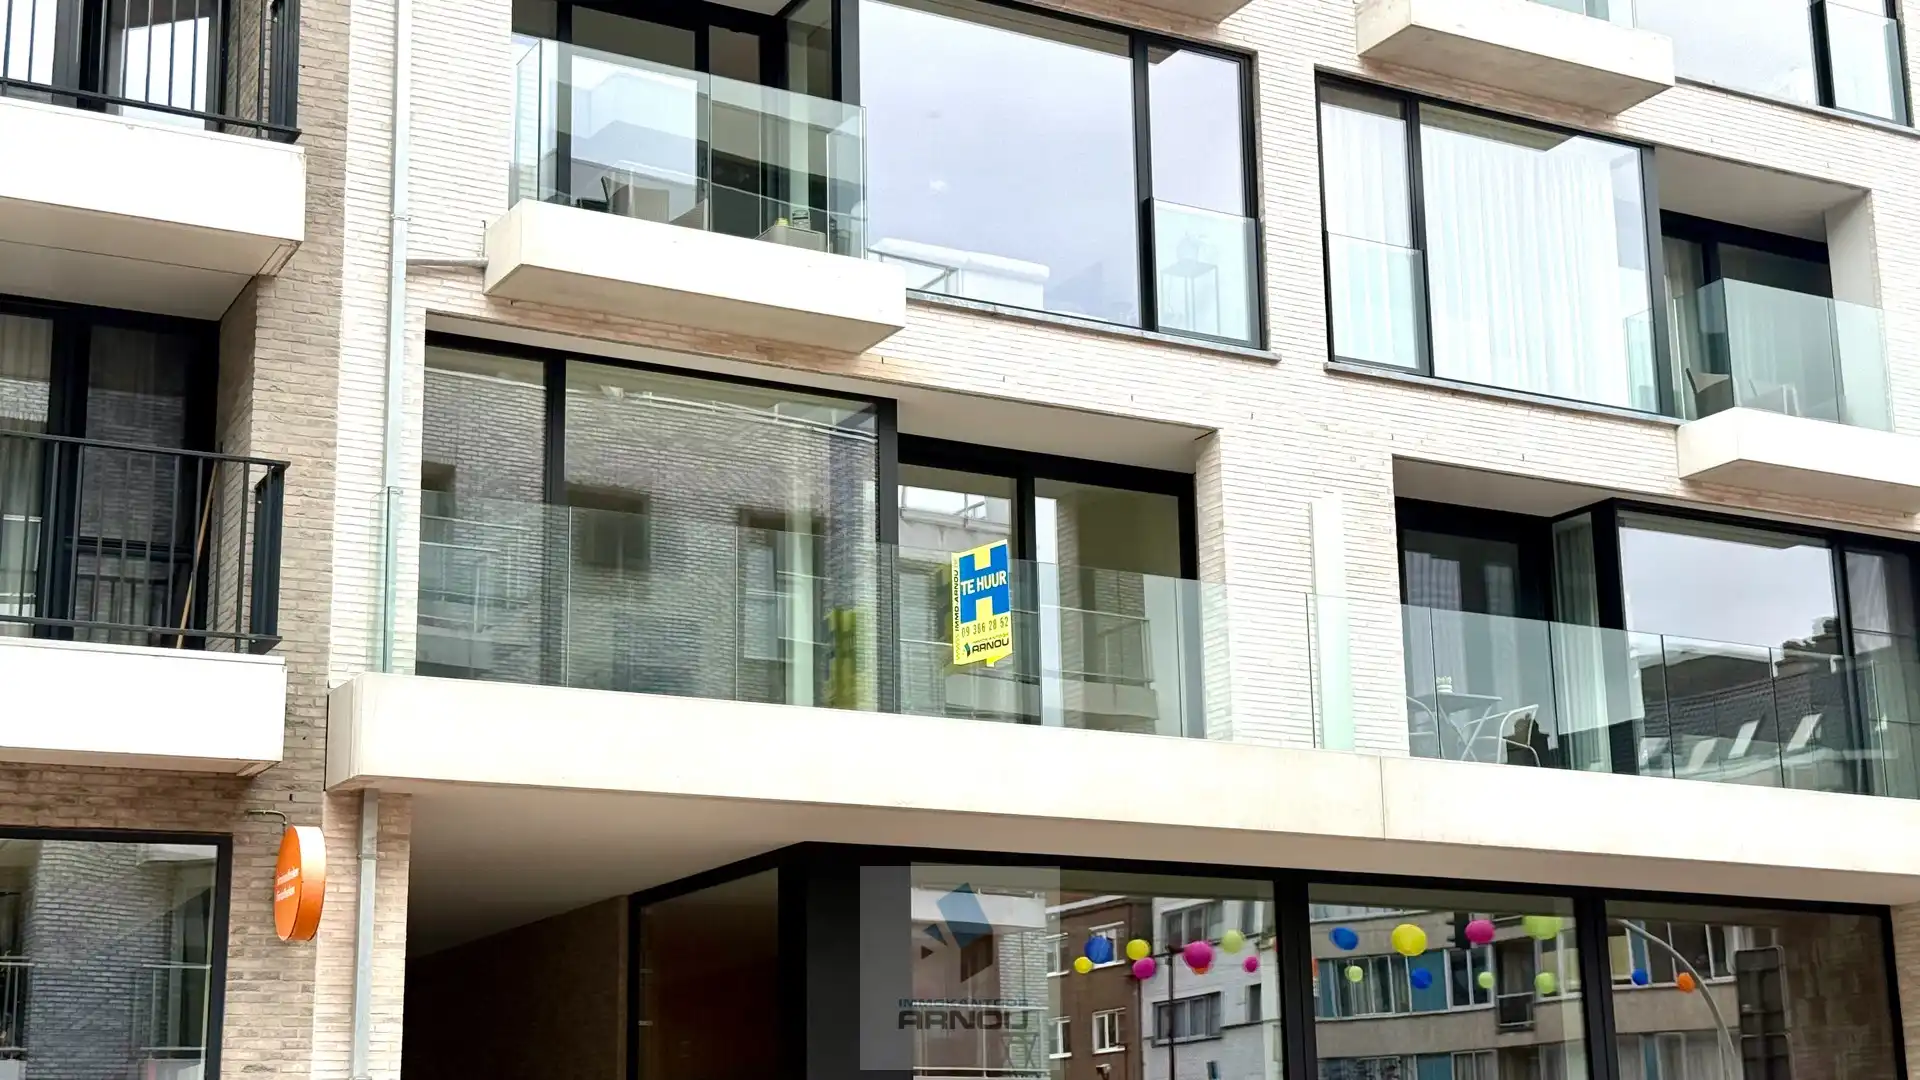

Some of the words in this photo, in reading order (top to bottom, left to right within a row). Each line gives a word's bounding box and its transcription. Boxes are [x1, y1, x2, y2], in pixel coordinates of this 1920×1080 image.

[961, 579, 975, 596] TE
[977, 570, 1007, 592] HUUR
[961, 626, 970, 638] 09
[988, 619, 997, 631] 28
[999, 616, 1009, 628] 52
[972, 637, 1009, 653] ARNOU
